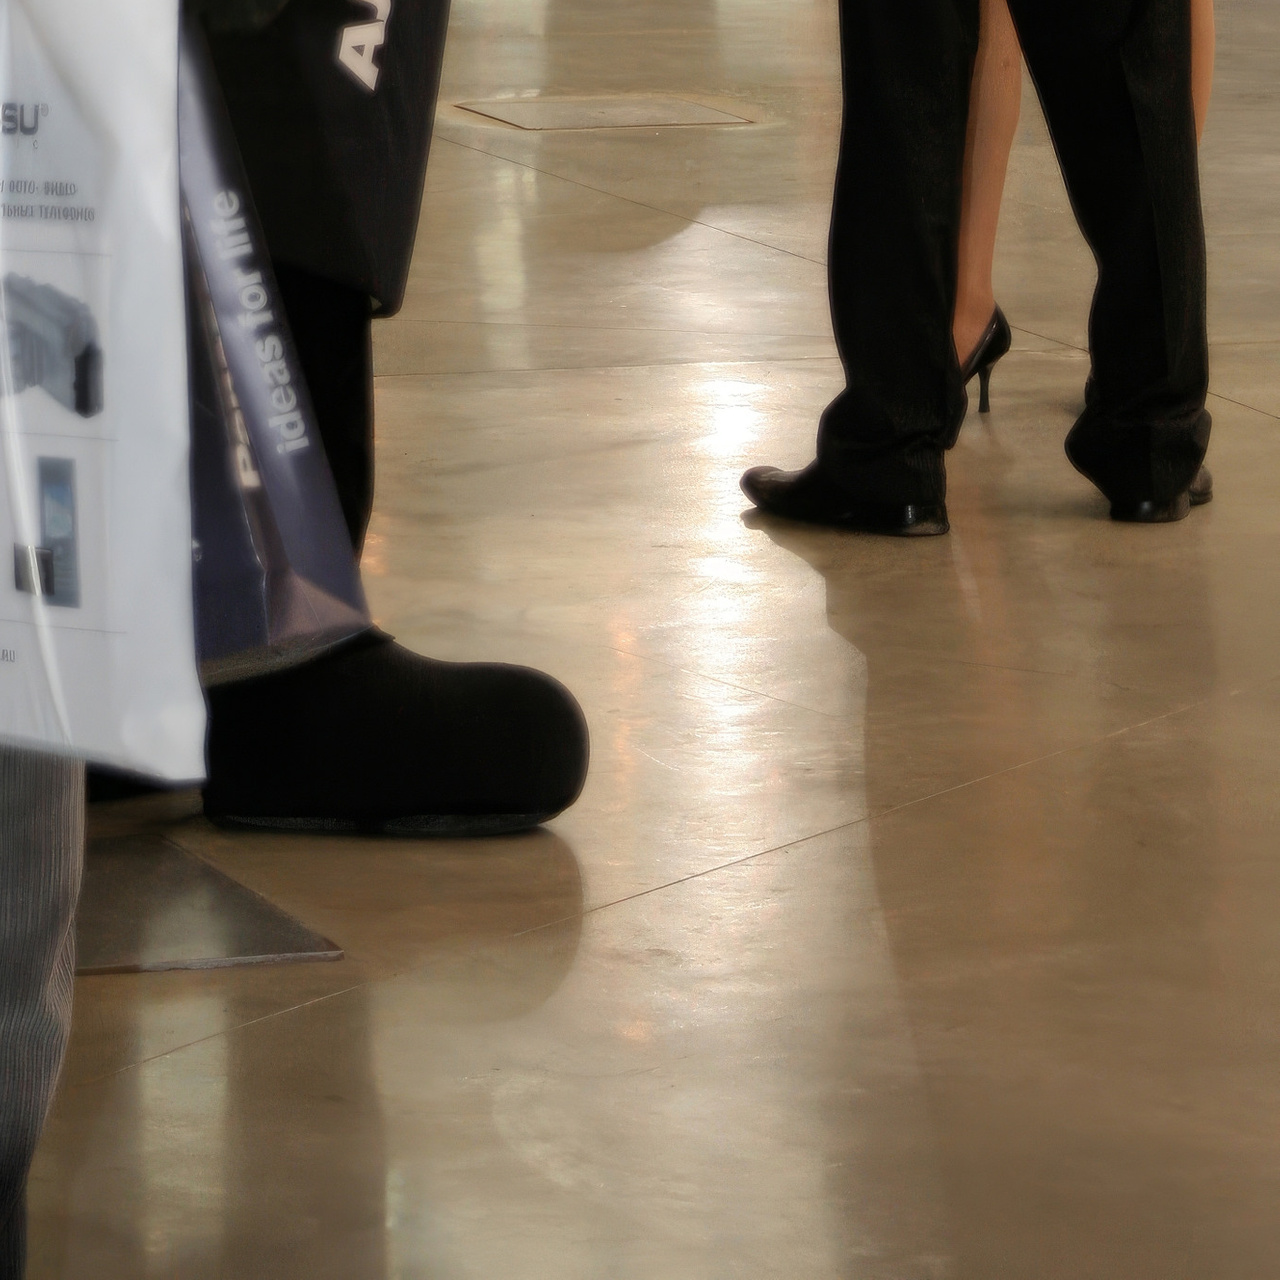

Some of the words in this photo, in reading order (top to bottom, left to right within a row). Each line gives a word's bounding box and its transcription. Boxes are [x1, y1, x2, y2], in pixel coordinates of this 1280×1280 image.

[210, 189, 254, 261] life
[232, 268, 274, 330] for
[255, 334, 310, 455] ideas
